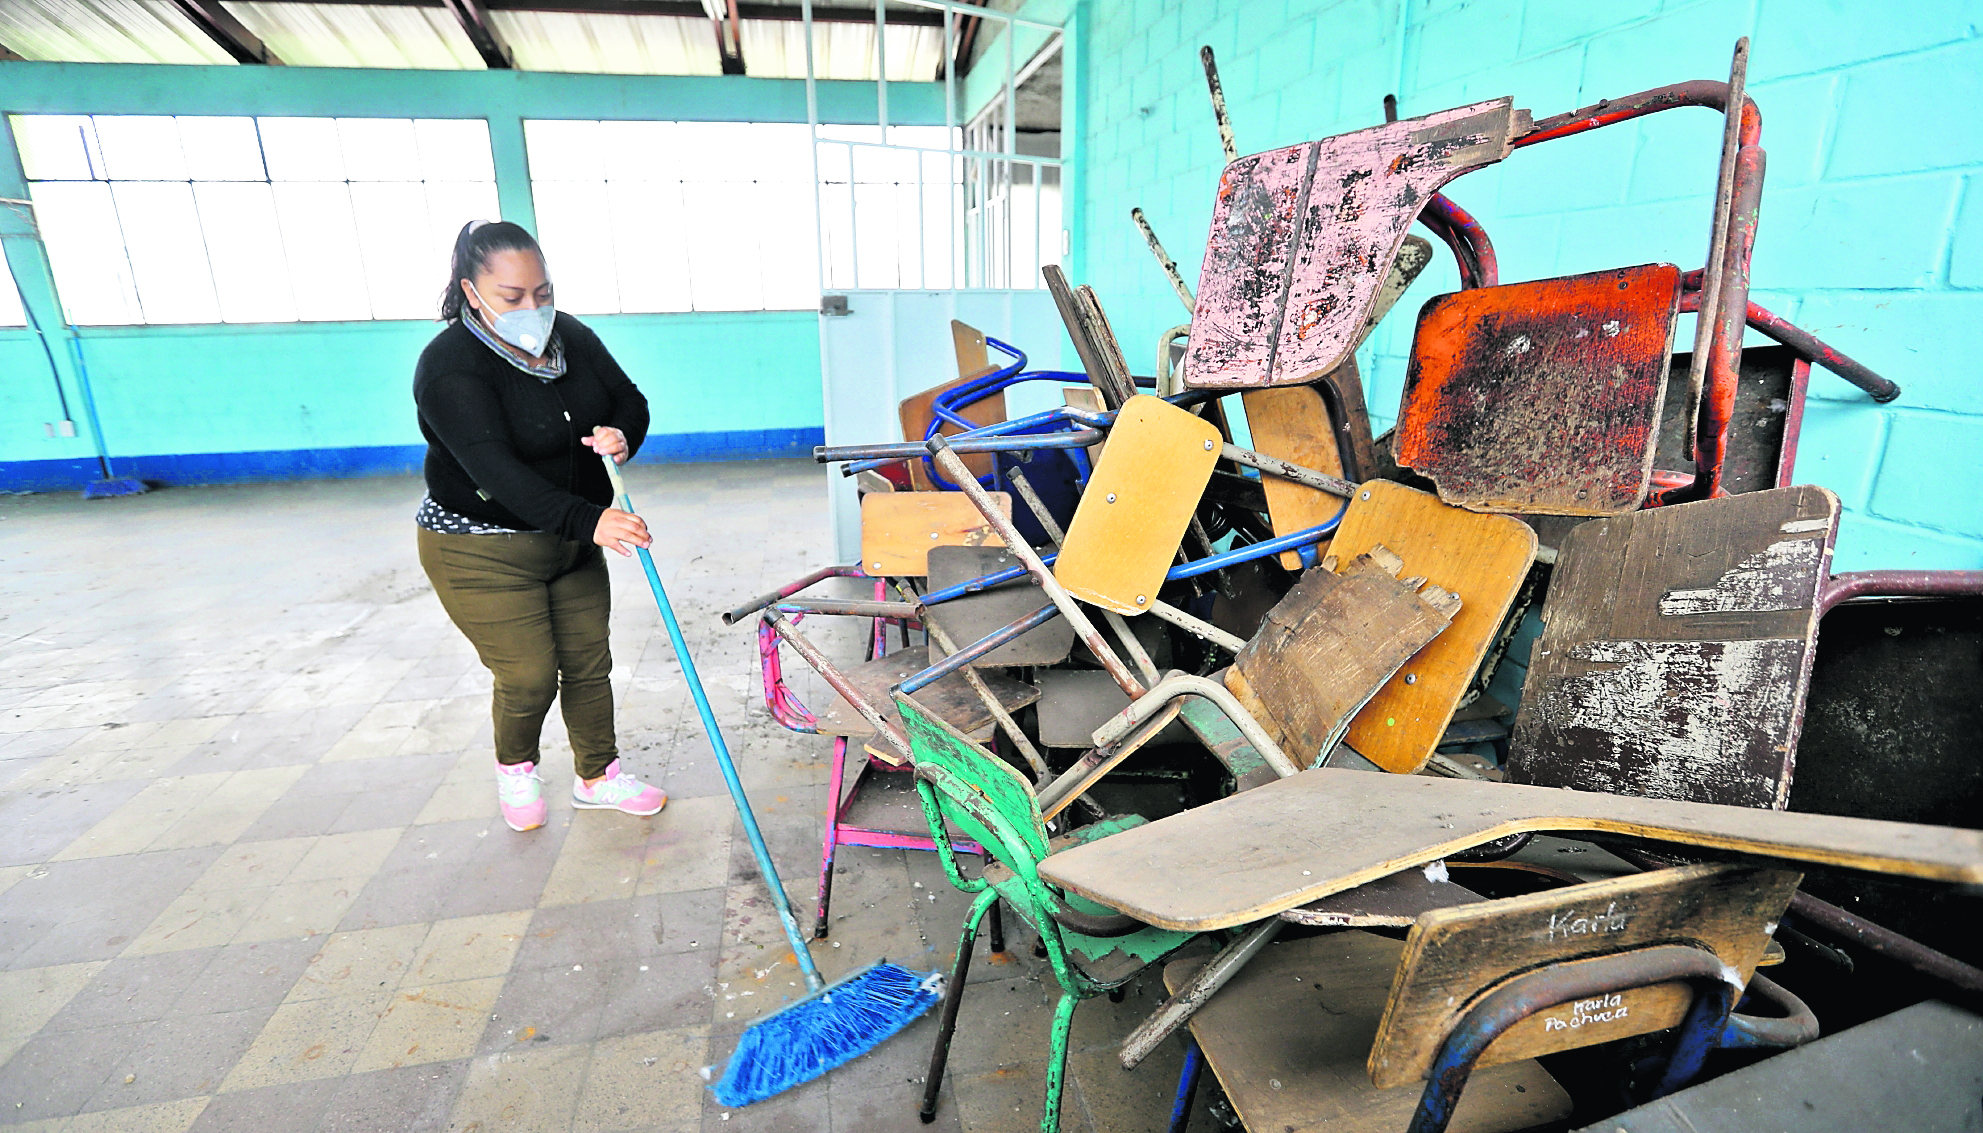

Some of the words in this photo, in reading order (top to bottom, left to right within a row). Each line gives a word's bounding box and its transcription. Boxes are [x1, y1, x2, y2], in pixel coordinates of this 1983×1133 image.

[600, 791, 618, 804] N
[1549, 901, 1625, 942] Karla
[1574, 993, 1622, 1015] Karla
